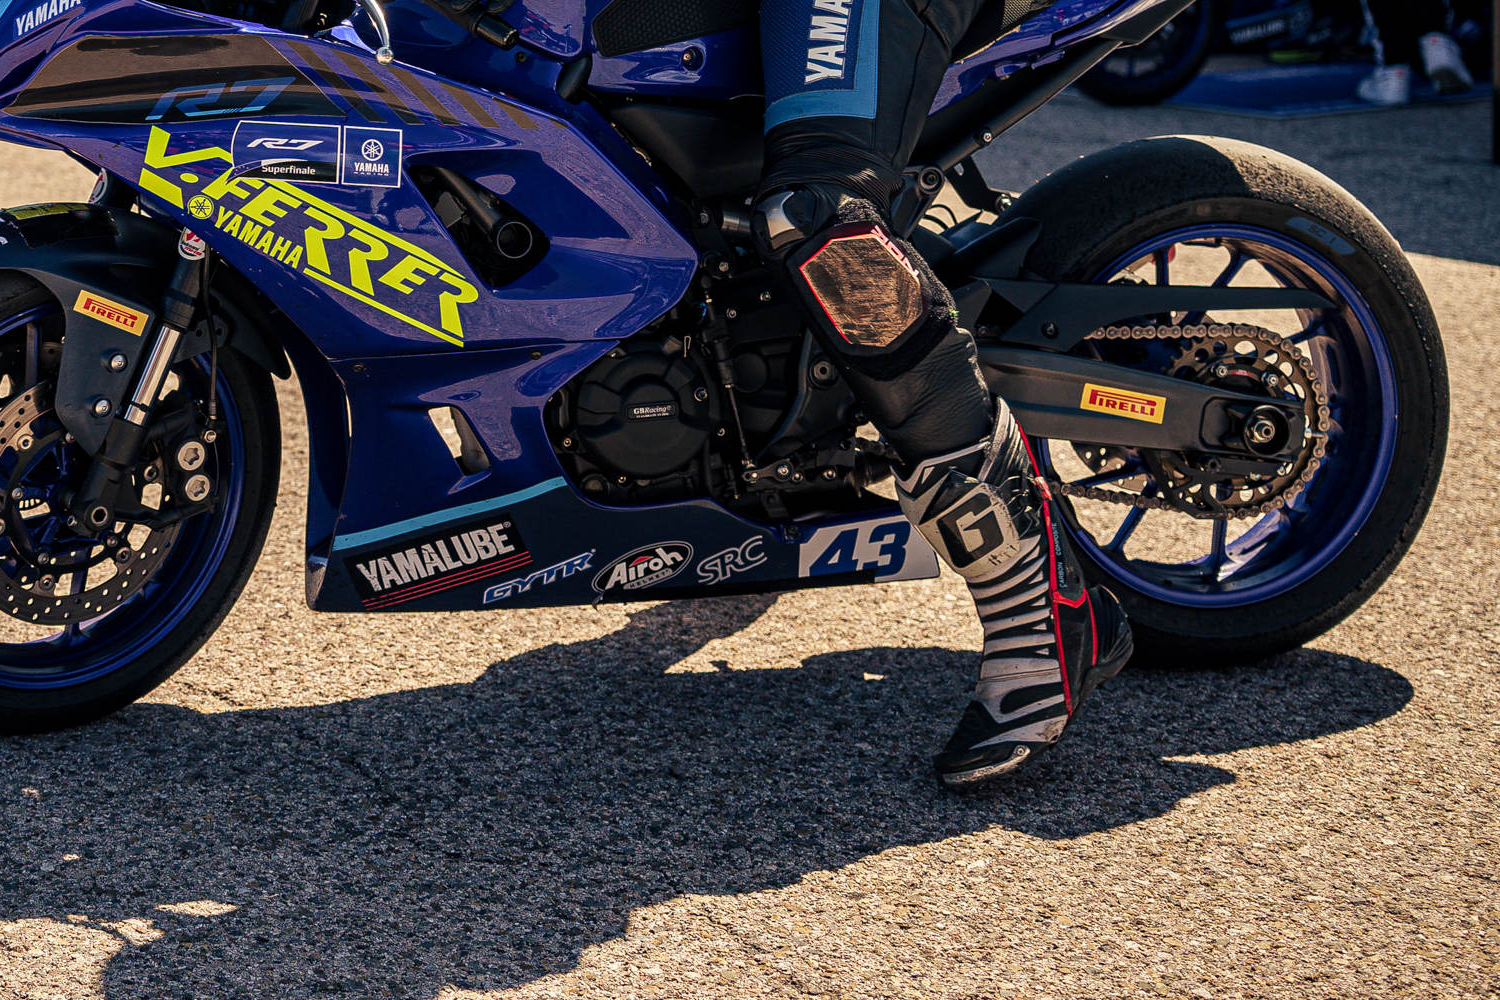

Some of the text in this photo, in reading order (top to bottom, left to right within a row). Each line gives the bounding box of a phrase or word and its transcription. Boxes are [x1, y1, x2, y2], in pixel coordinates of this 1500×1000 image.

[145, 77, 297, 121] R7
[247, 137, 324, 151] R7
[261, 164, 316, 177] Superfinale
[354, 162, 390, 174] YAMAHA
[213, 205, 304, 271] YAMAHA
[83, 297, 138, 328] PIRELLI
[1088, 388, 1157, 417] PIRELLI
[356, 521, 516, 592] YAMALUBE
[605, 546, 685, 590] Airoh
[696, 535, 768, 586] SRC
[809, 520, 911, 577] 43
[483, 551, 594, 605] GYTR
